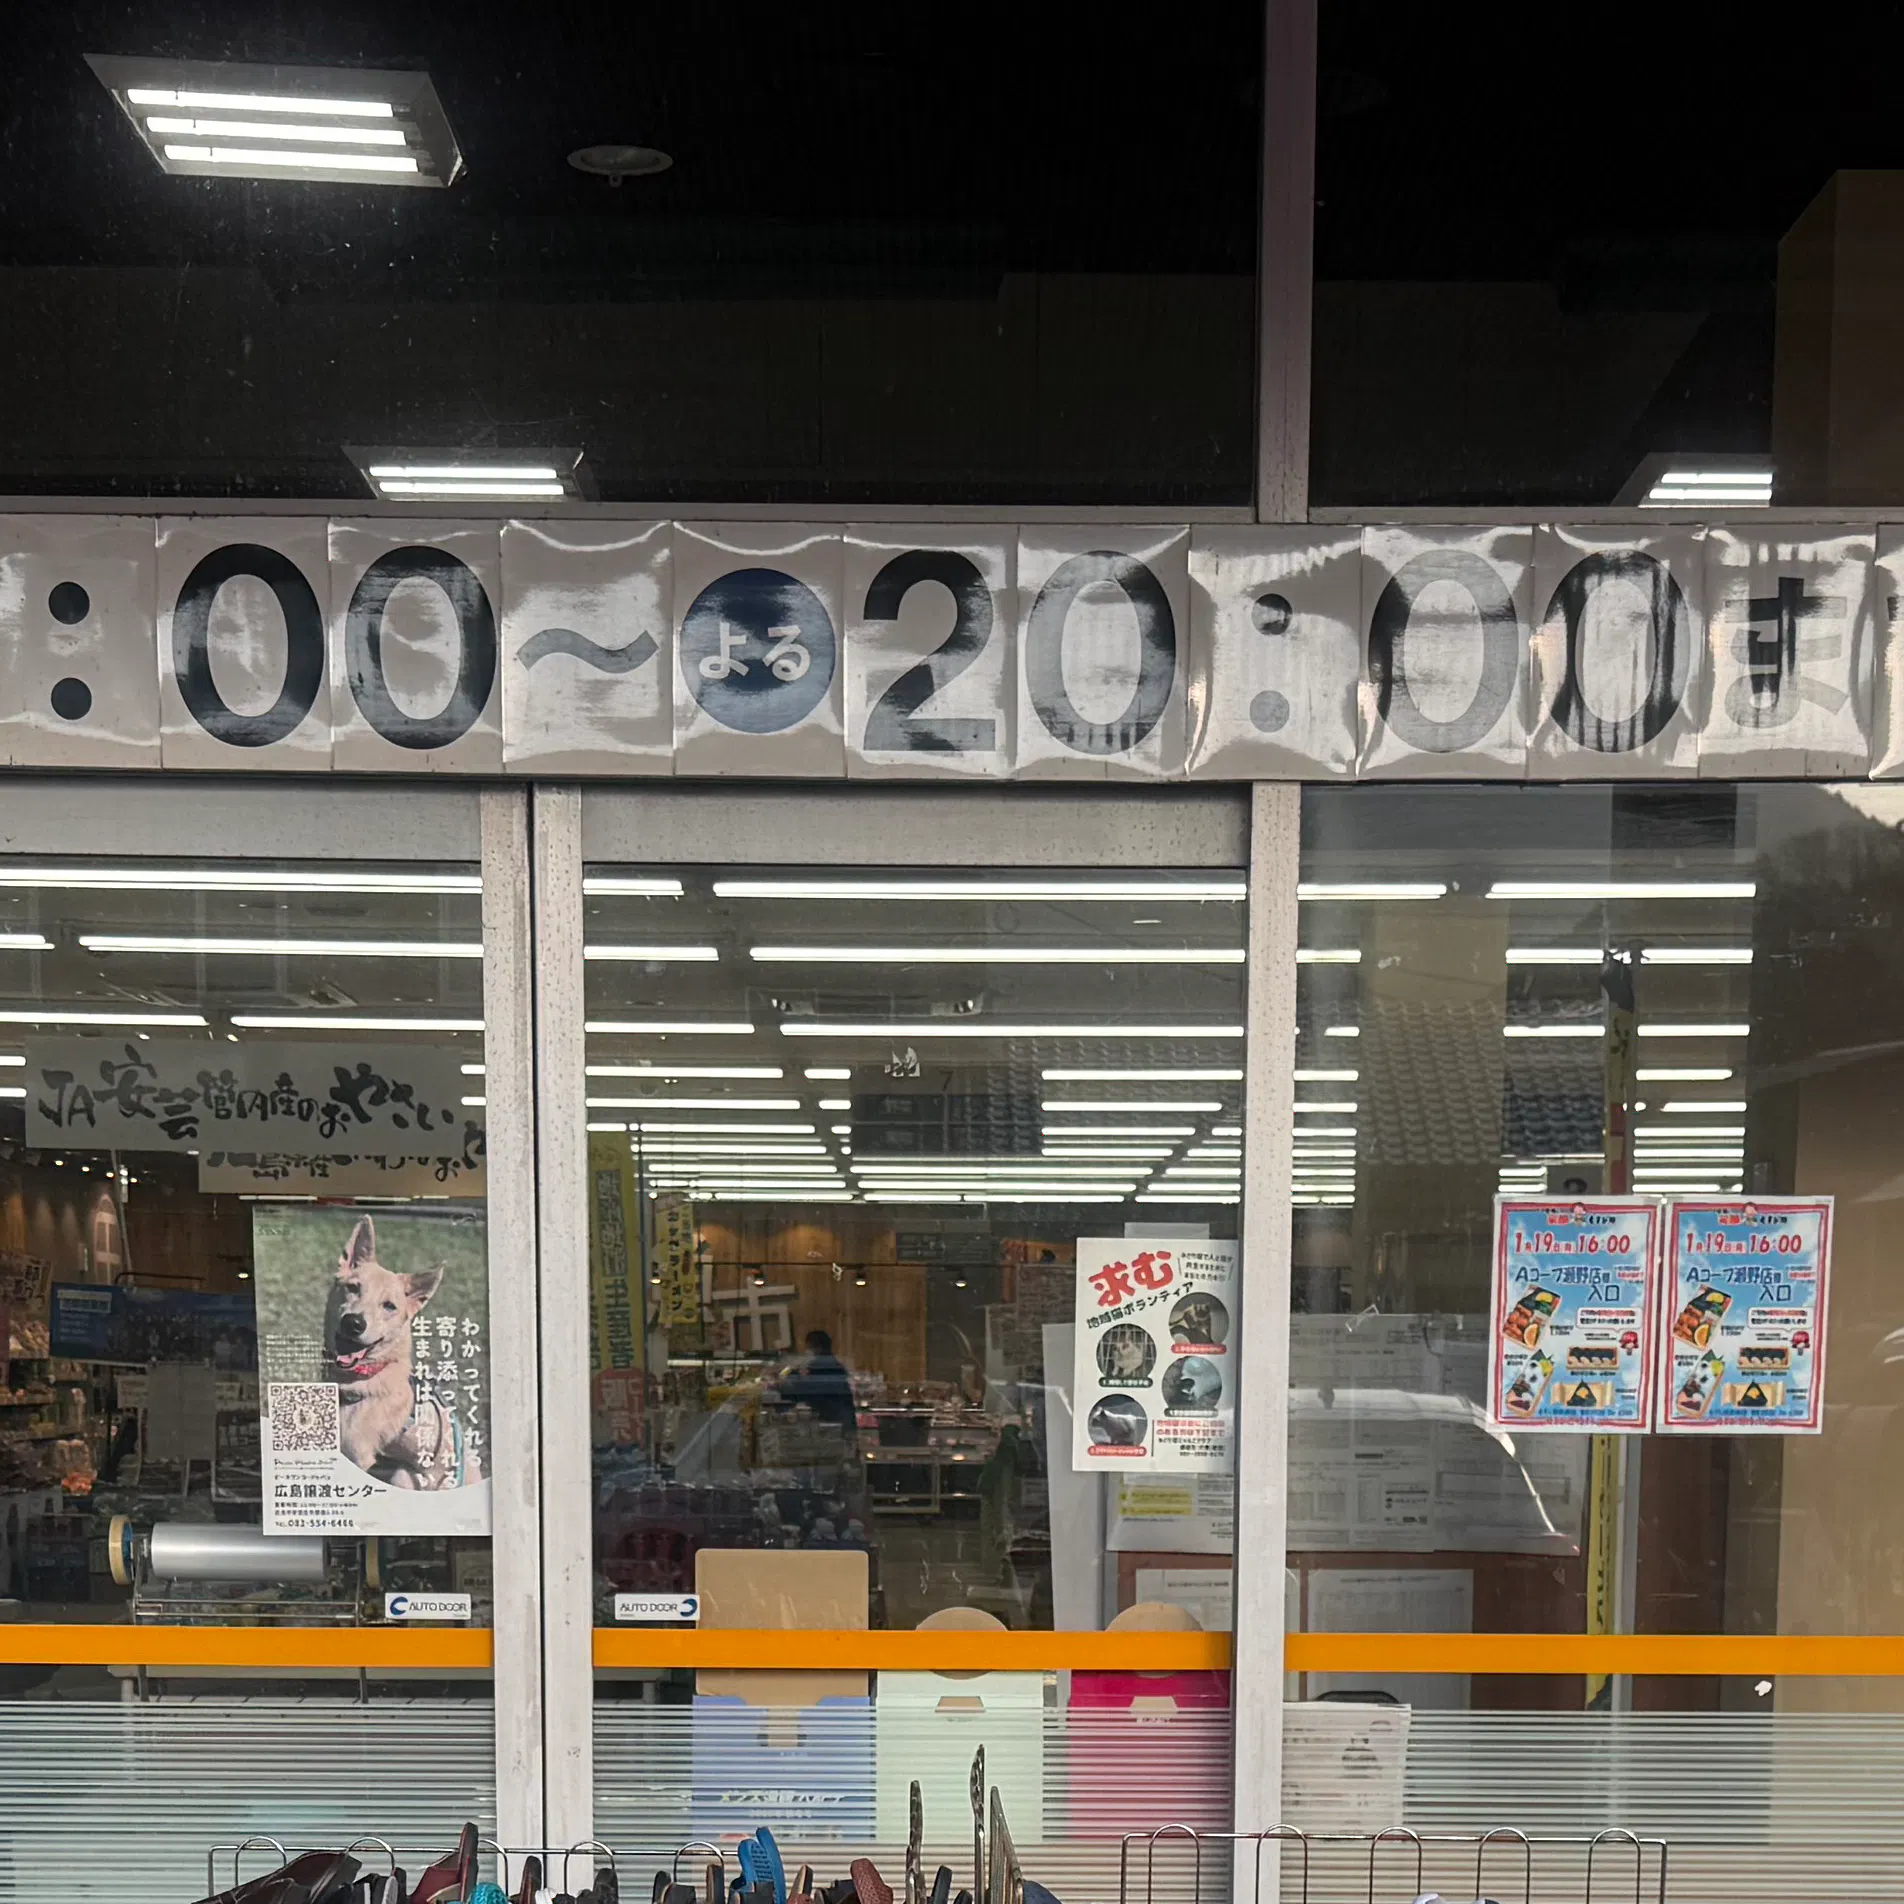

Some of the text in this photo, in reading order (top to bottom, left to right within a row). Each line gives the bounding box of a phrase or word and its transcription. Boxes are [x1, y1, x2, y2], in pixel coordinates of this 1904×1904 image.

[1579, 1235, 1630, 1253] 16:00
[1750, 1234, 1802, 1253] 16:00
[1088, 1250, 1174, 1307] 求む
[1588, 1285, 1620, 1302] 入口
[1759, 1285, 1791, 1302] 入口
[274, 1484, 387, 1499] 広島譲渡センター
[409, 1602, 437, 1612] AUTO
[620, 1603, 647, 1612] AUTO
